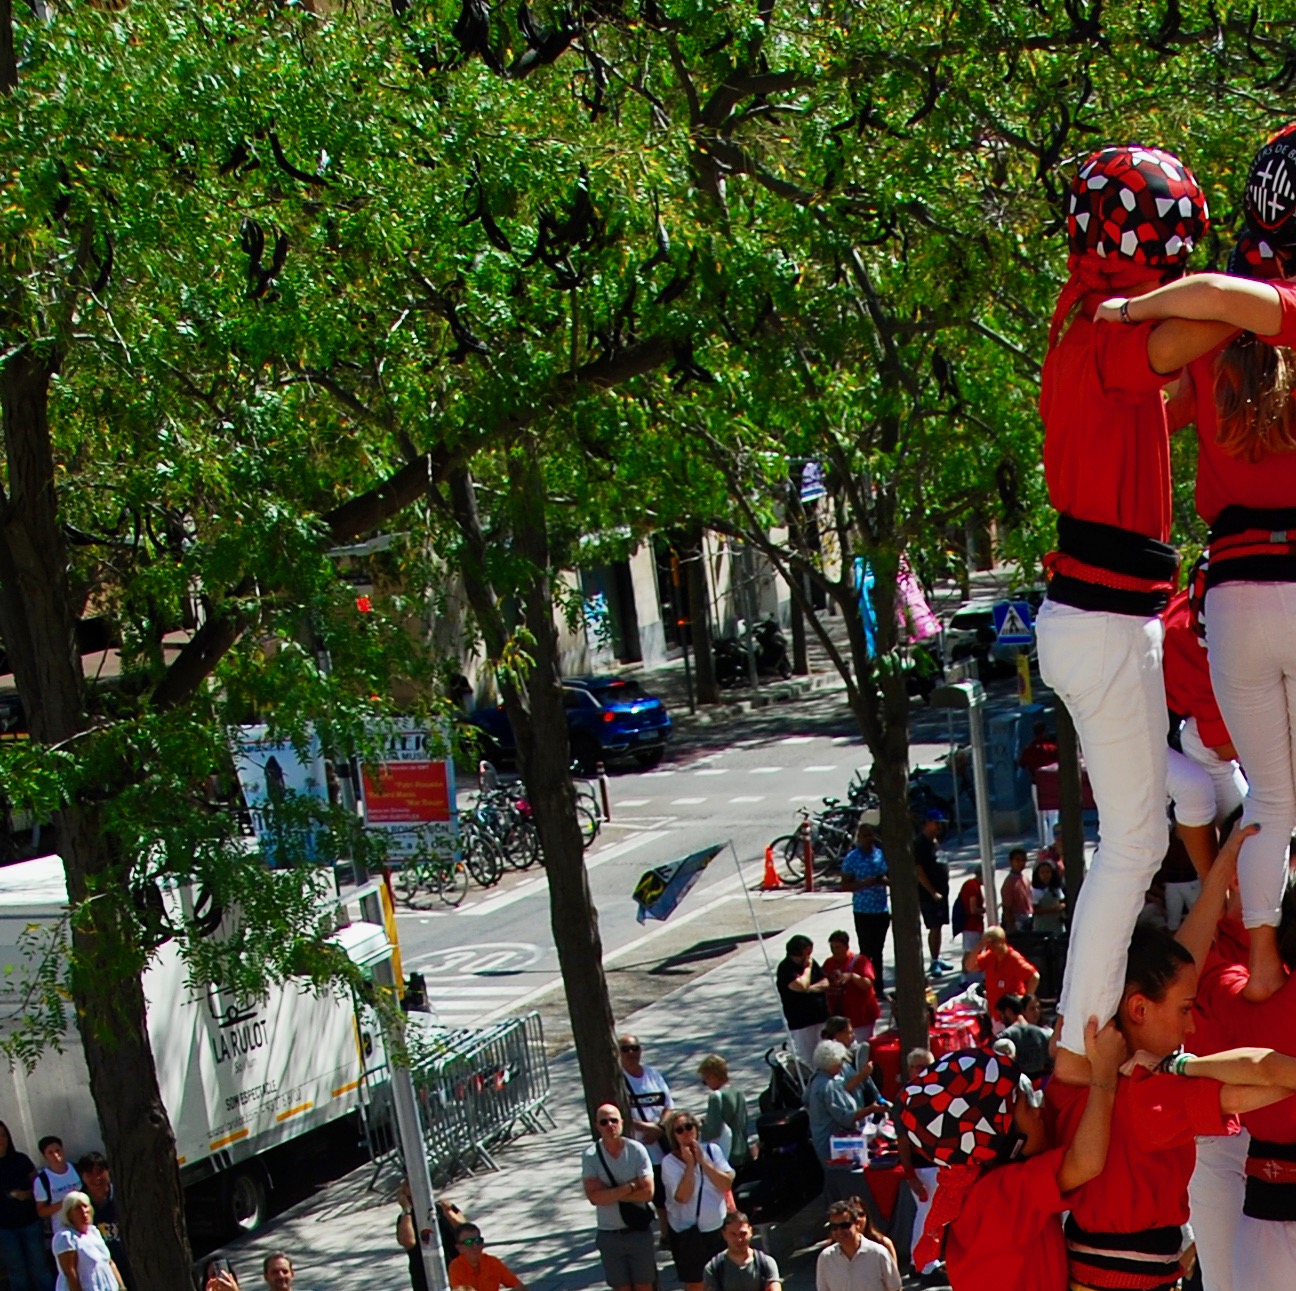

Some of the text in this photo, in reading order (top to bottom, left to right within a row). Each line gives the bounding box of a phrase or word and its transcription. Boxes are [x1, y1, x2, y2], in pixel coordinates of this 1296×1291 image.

[417, 951, 518, 973] 30
[212, 1019, 268, 1064] LA RULOT
